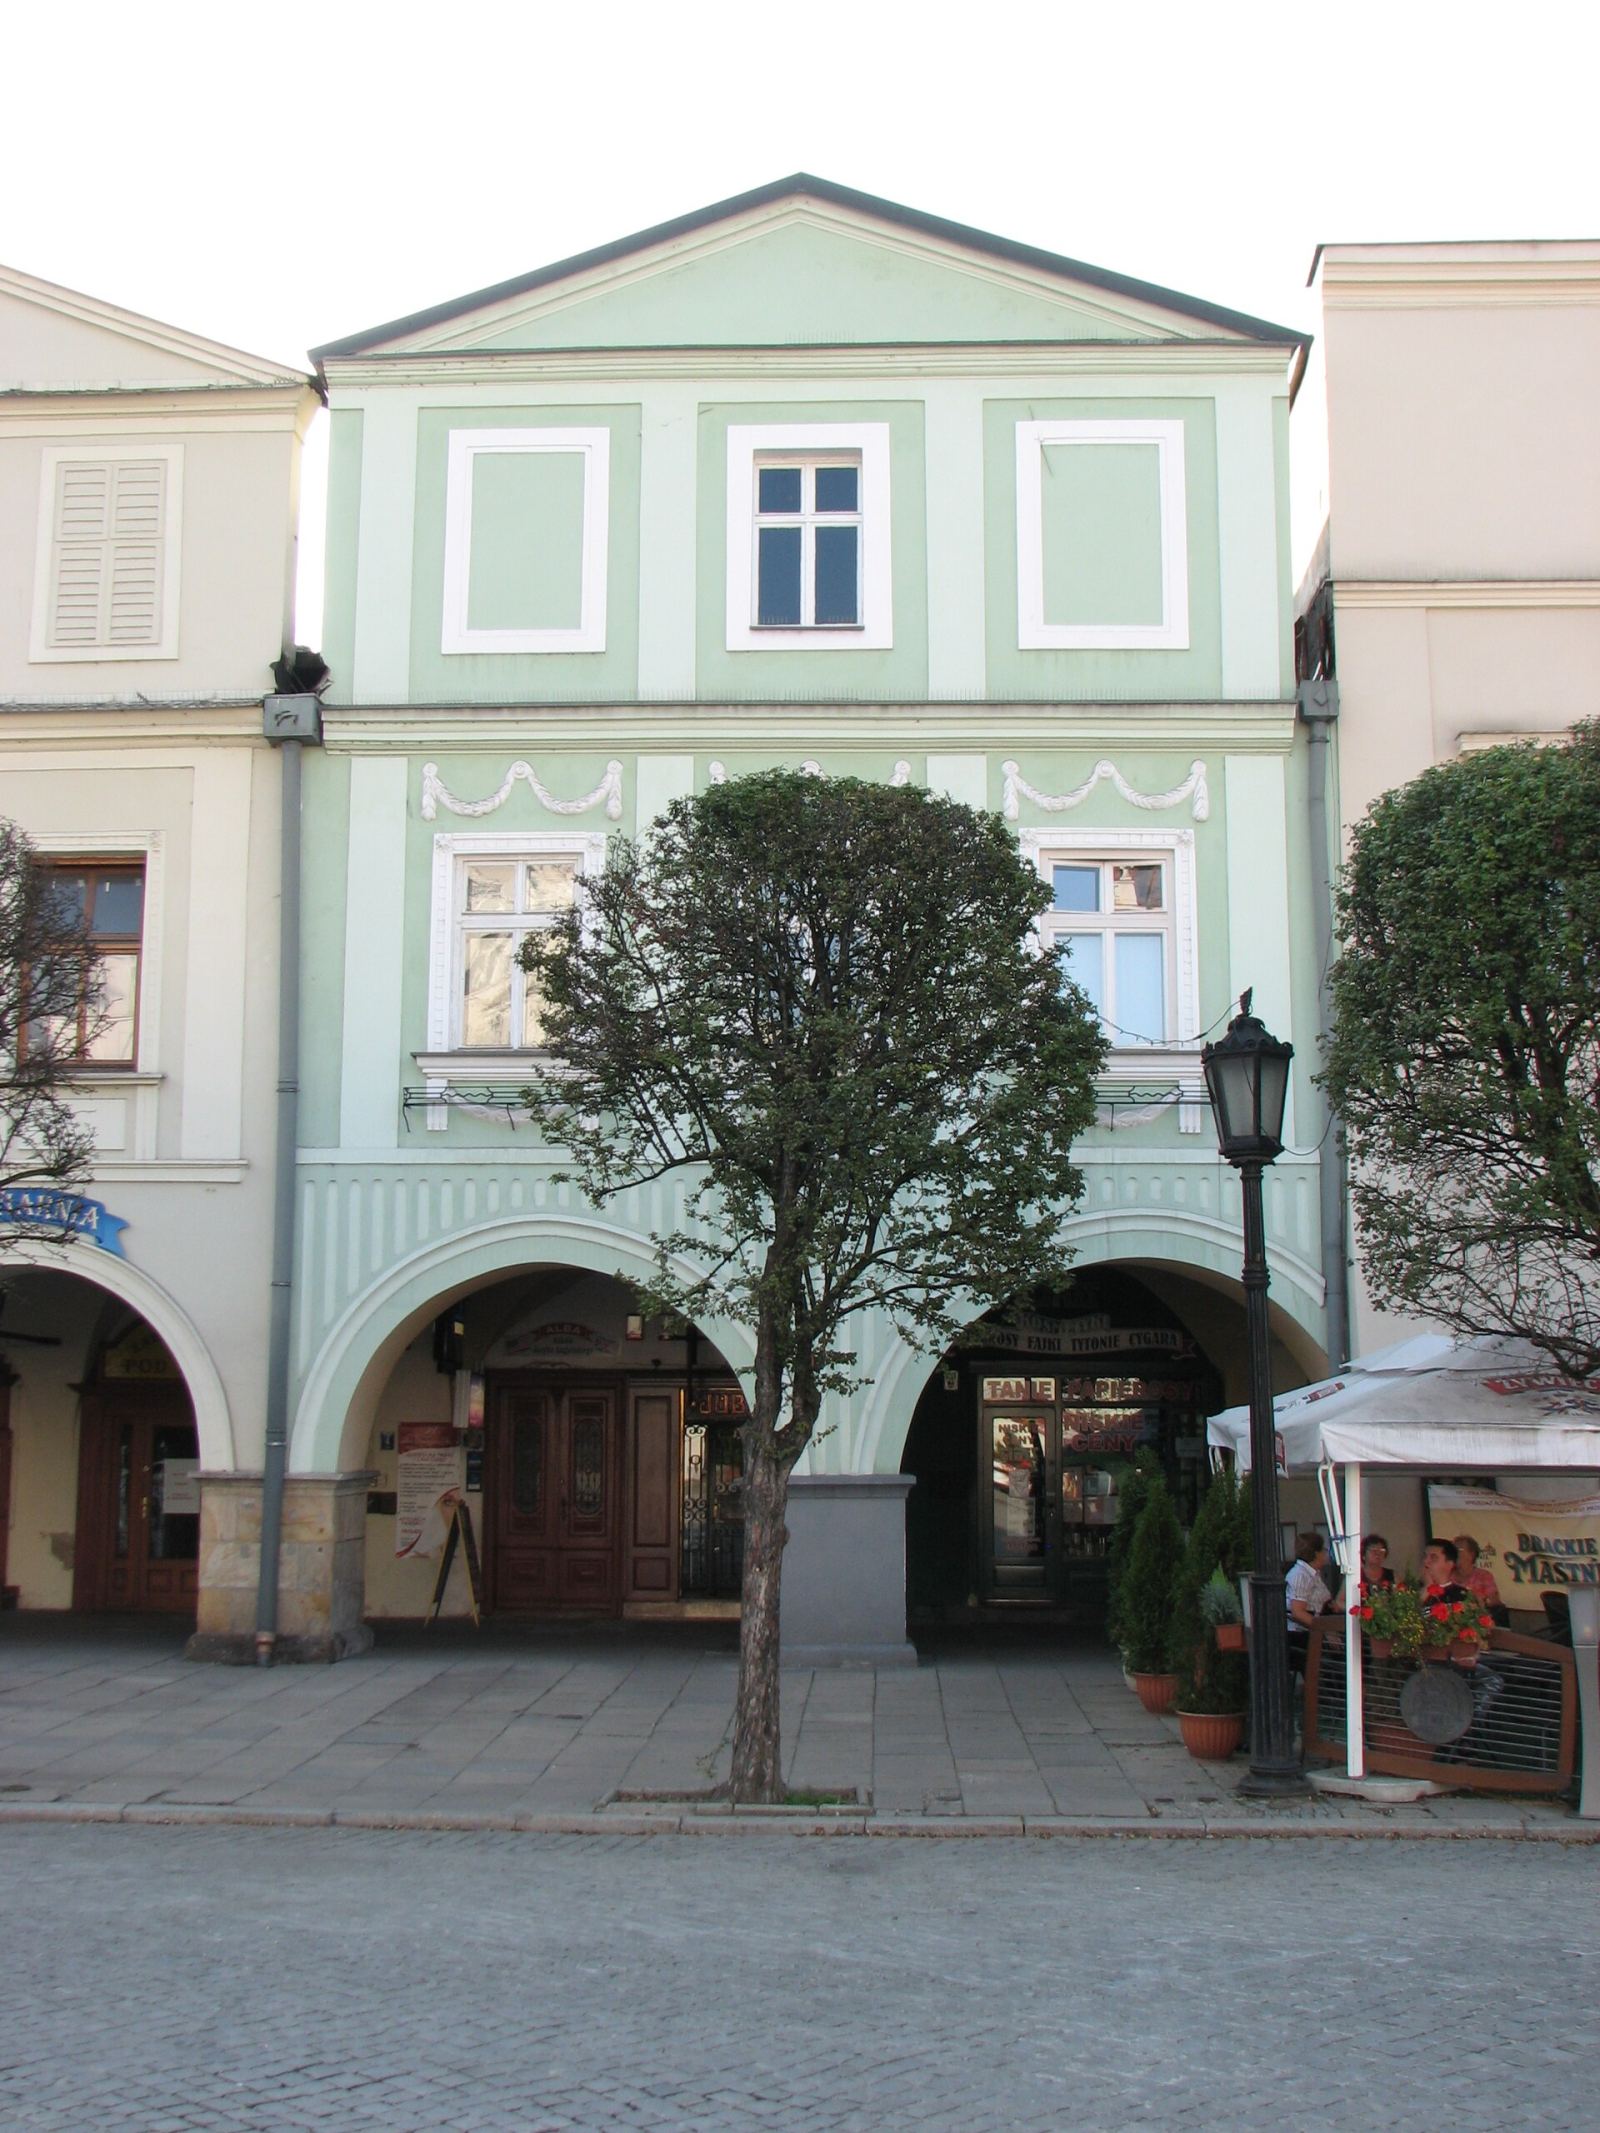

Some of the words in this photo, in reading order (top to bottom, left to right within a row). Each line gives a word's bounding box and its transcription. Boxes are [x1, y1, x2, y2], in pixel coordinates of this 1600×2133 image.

[1027, 1336, 1061, 1351] FAJKI
[1071, 1335, 1120, 1351] TYTONIE
[1129, 1332, 1177, 1347] CYGARA
[986, 1380, 1054, 1400] TANIE
[1067, 1378, 1196, 1401] PAPIEROSY
[1063, 1413, 1143, 1432] NISKIE
[1072, 1433, 1136, 1452] CENY
[1516, 1533, 1598, 1555] BRACKIE
[1503, 1551, 1600, 1584] MASTN
